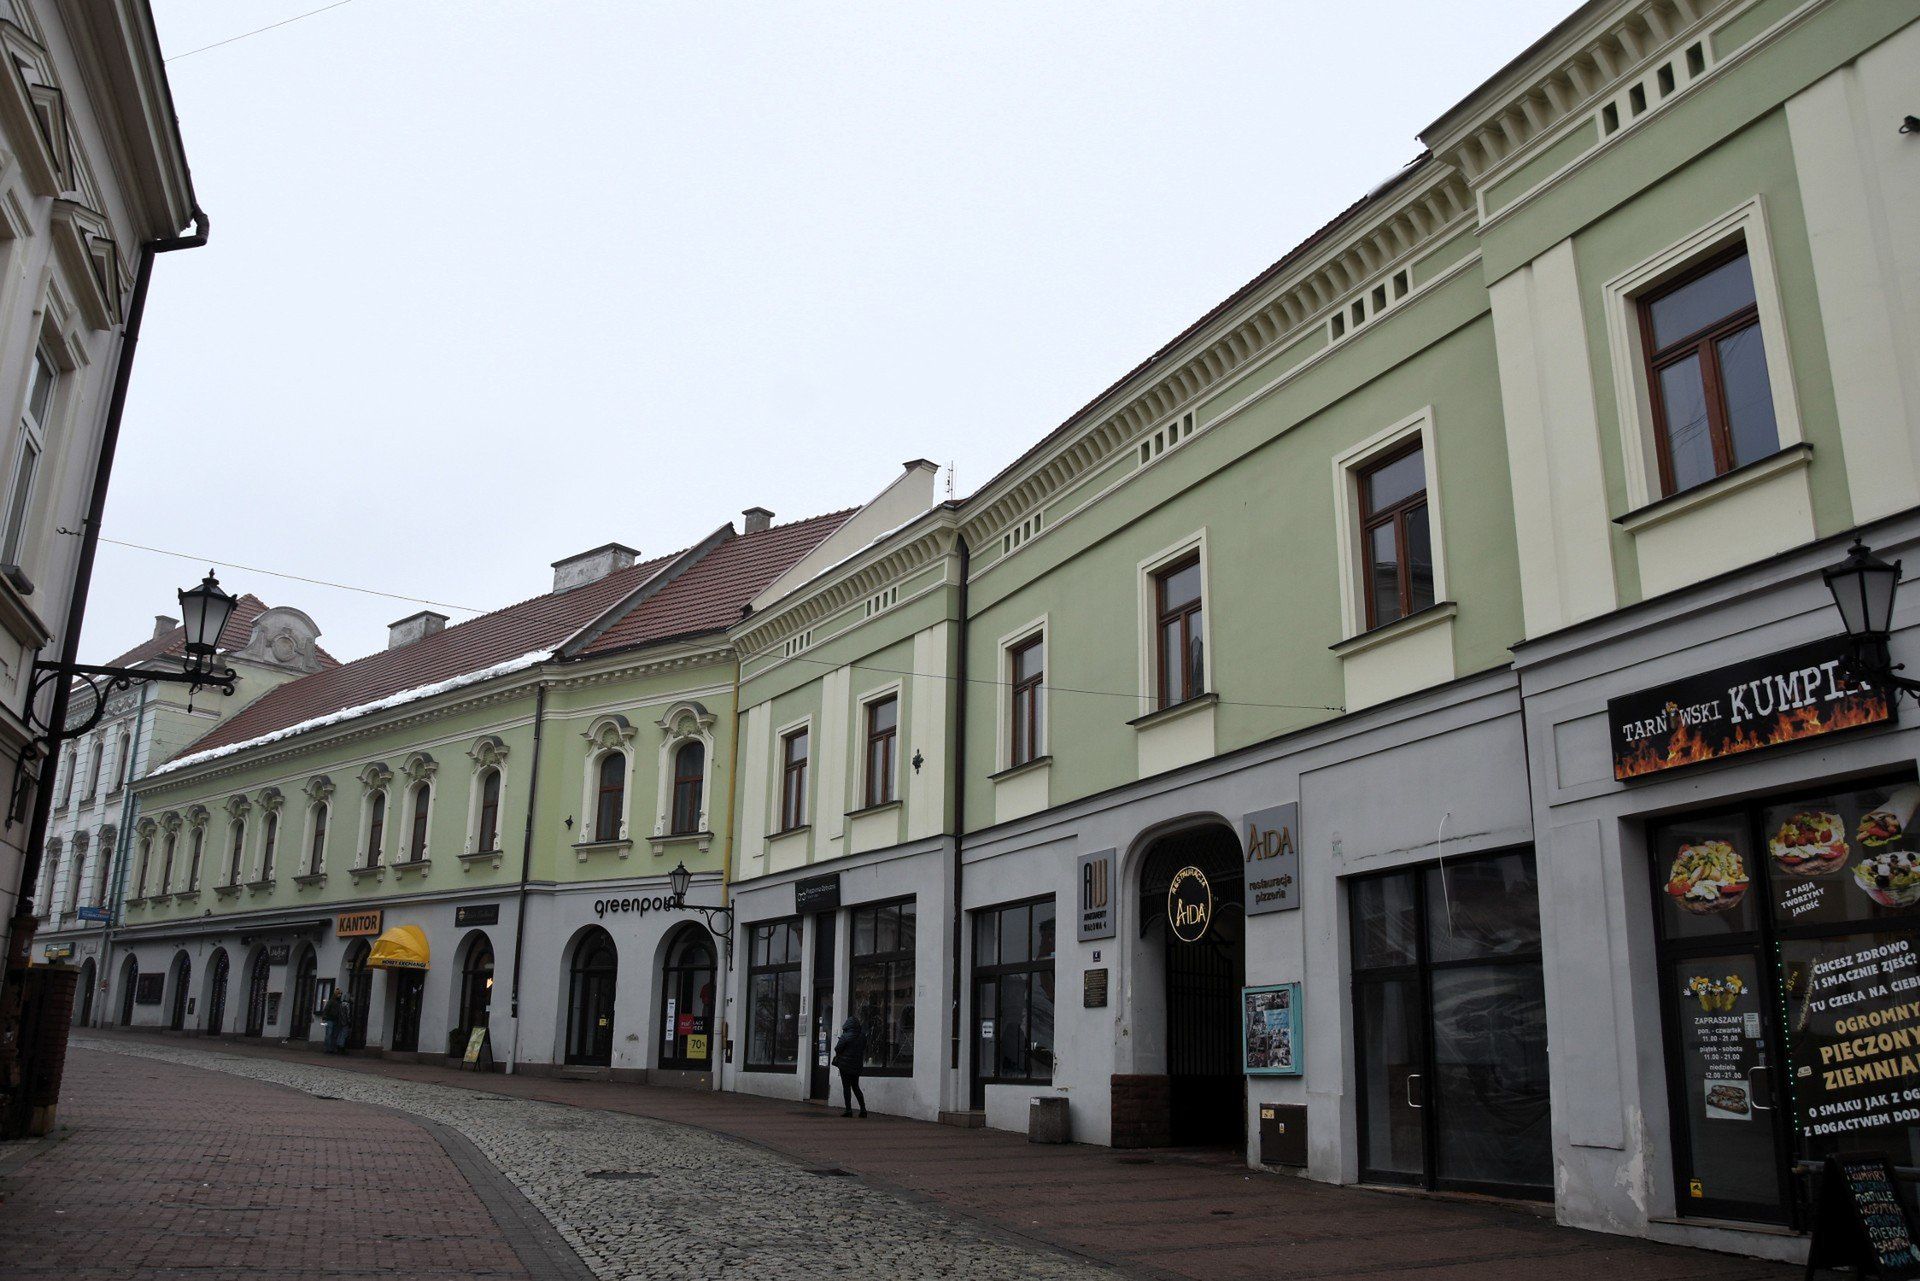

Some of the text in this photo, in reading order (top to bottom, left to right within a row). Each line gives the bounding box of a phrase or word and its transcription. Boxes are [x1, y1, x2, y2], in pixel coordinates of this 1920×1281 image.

[1622, 660, 1872, 742] TARNWSKI KUMPI
[1245, 822, 1294, 863] AIDA
[1249, 873, 1293, 892] restauracja
[594, 895, 681, 919] greenpoin
[1255, 889, 1286, 906] pizzeria
[1780, 887, 1825, 909] TWORZYMY
[339, 914, 377, 933] KANTOR
[1176, 898, 1206, 928] AIDA
[1813, 939, 1909, 976] CHCESZ ZDROWO
[1813, 952, 1918, 990] I SMACZNIE ZJEŚĆ?
[1810, 974, 1920, 1013] TU CZEKA NA CIEBI
[1694, 1016, 1743, 1024] ZAPRASZAMY
[1835, 1000, 1920, 1036] OGROMNY
[1822, 1052, 1920, 1091] ZIEMNIA
[1808, 1107, 1818, 1119] O
[1819, 1098, 1863, 1117] SMAKU
[1864, 1096, 1889, 1111] JAK
[1890, 1092, 1901, 1104] Z
[1803, 1127, 1812, 1138] Z
[1814, 1112, 1891, 1135] BOGACTWEM
[1871, 1226, 1909, 1241] PIEROGI
